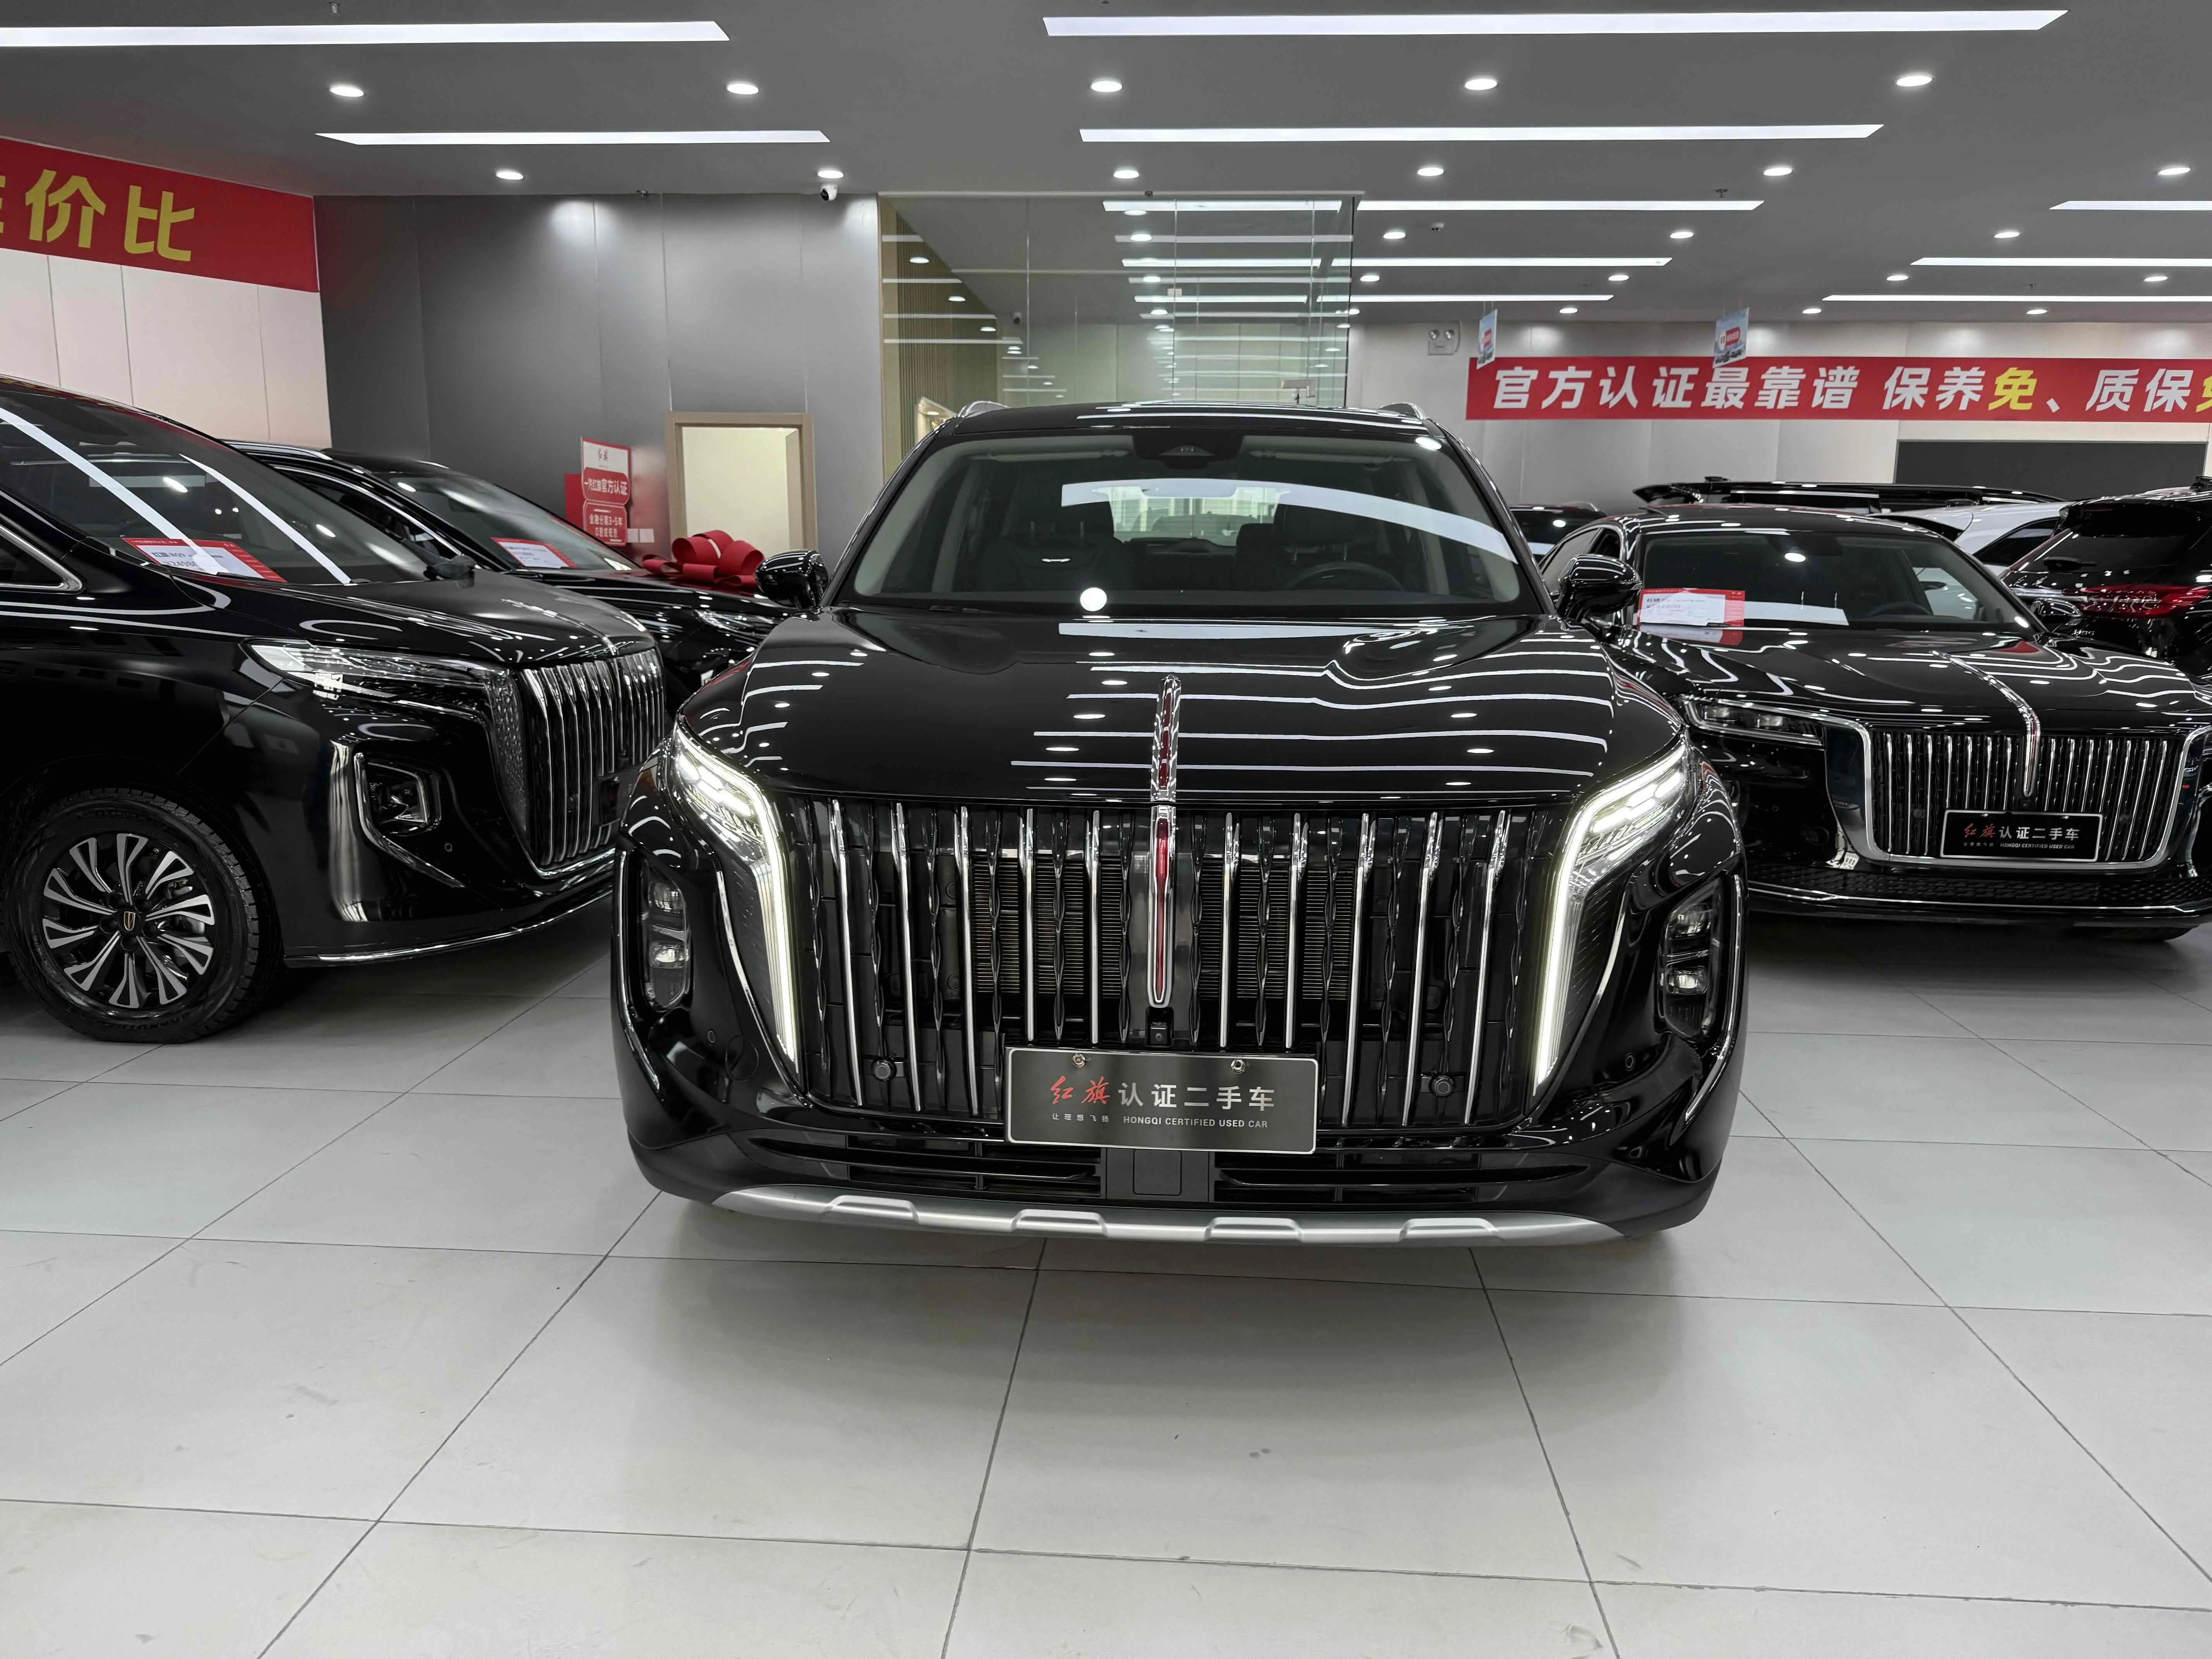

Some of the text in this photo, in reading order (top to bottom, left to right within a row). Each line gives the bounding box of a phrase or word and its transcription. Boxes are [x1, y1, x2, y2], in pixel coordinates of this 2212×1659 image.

[0, 169, 195, 261] 价比
[1493, 365, 1860, 410] 官方认证最靠谱
[1051, 1113, 1109, 1122] 让理想飞扬
[1123, 1115, 1267, 1128] HONGQI CERTIFIED USED CAR
